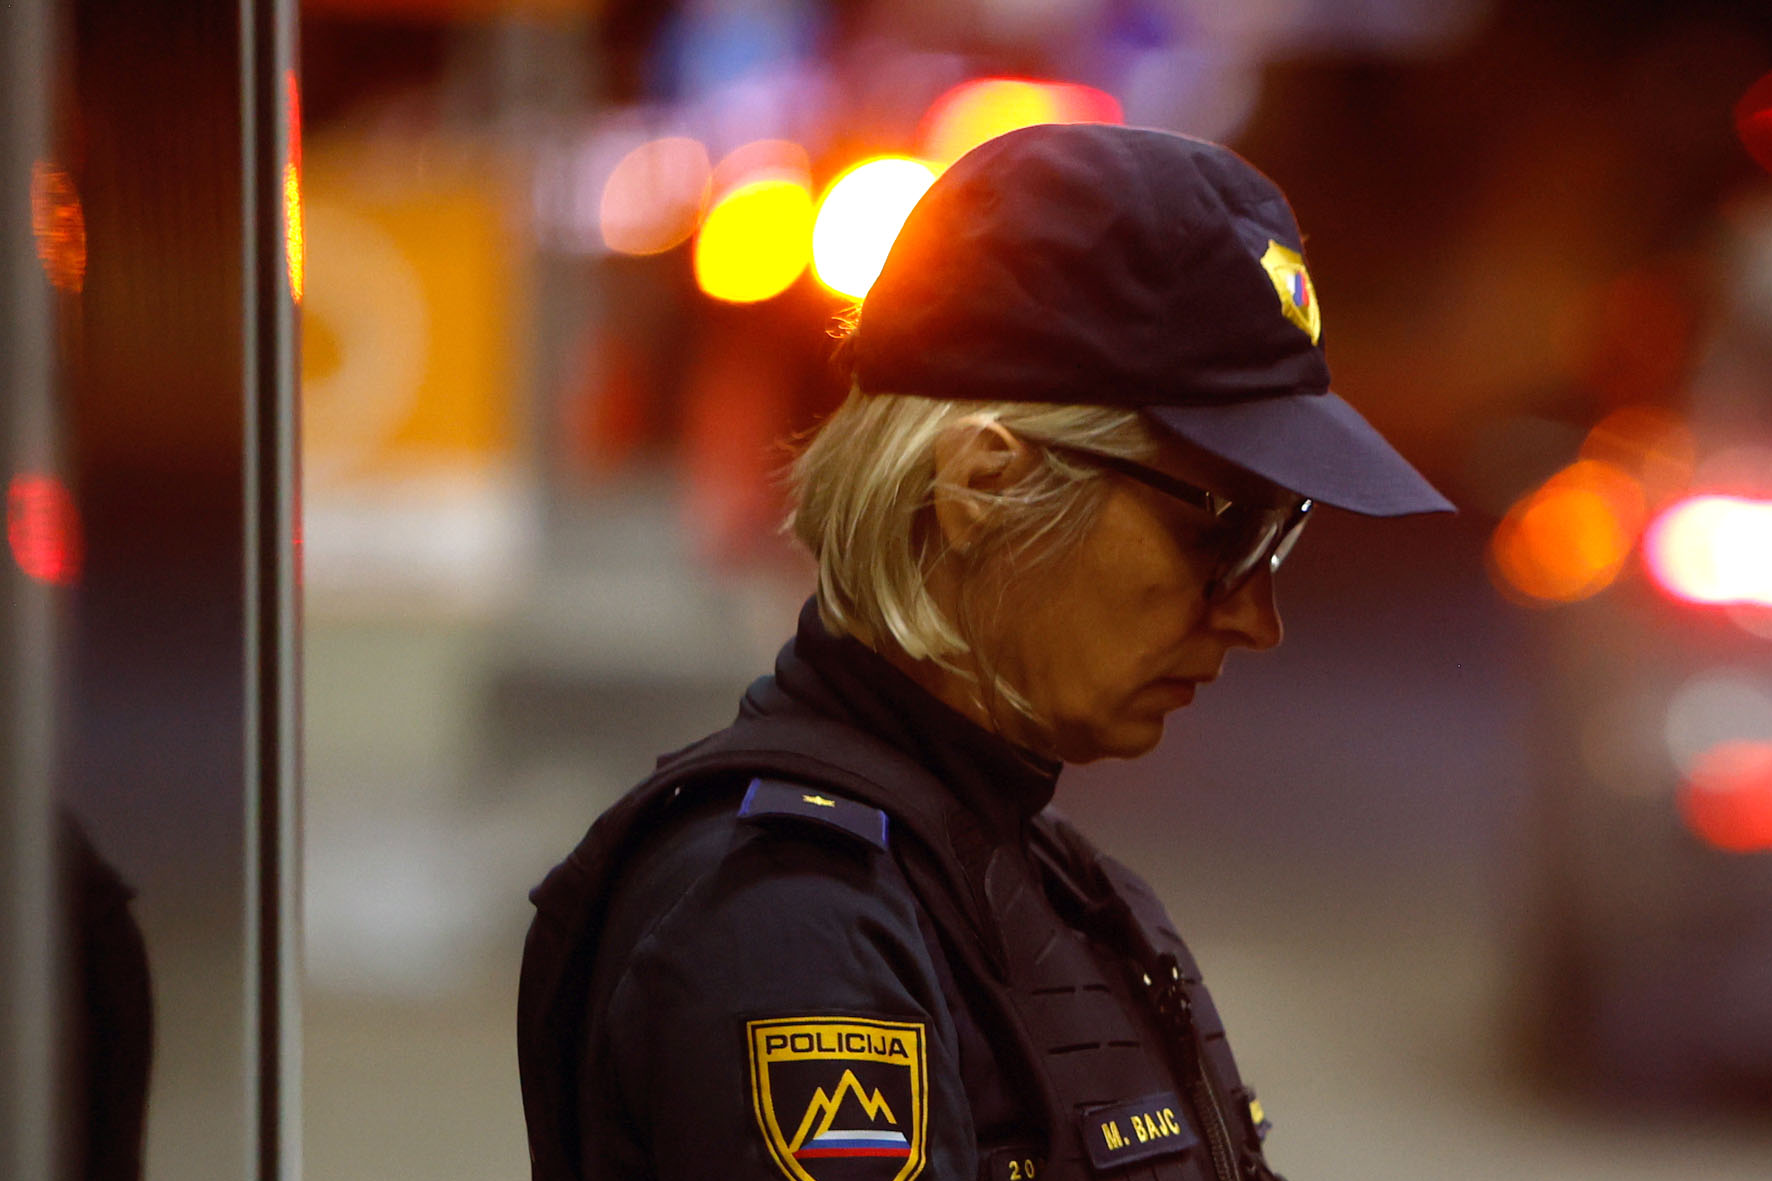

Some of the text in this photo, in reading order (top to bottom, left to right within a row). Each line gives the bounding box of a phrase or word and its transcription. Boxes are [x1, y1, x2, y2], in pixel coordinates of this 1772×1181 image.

[765, 1032, 909, 1058] POLICIJA
[1101, 1107, 1181, 1151] M. BAJC
